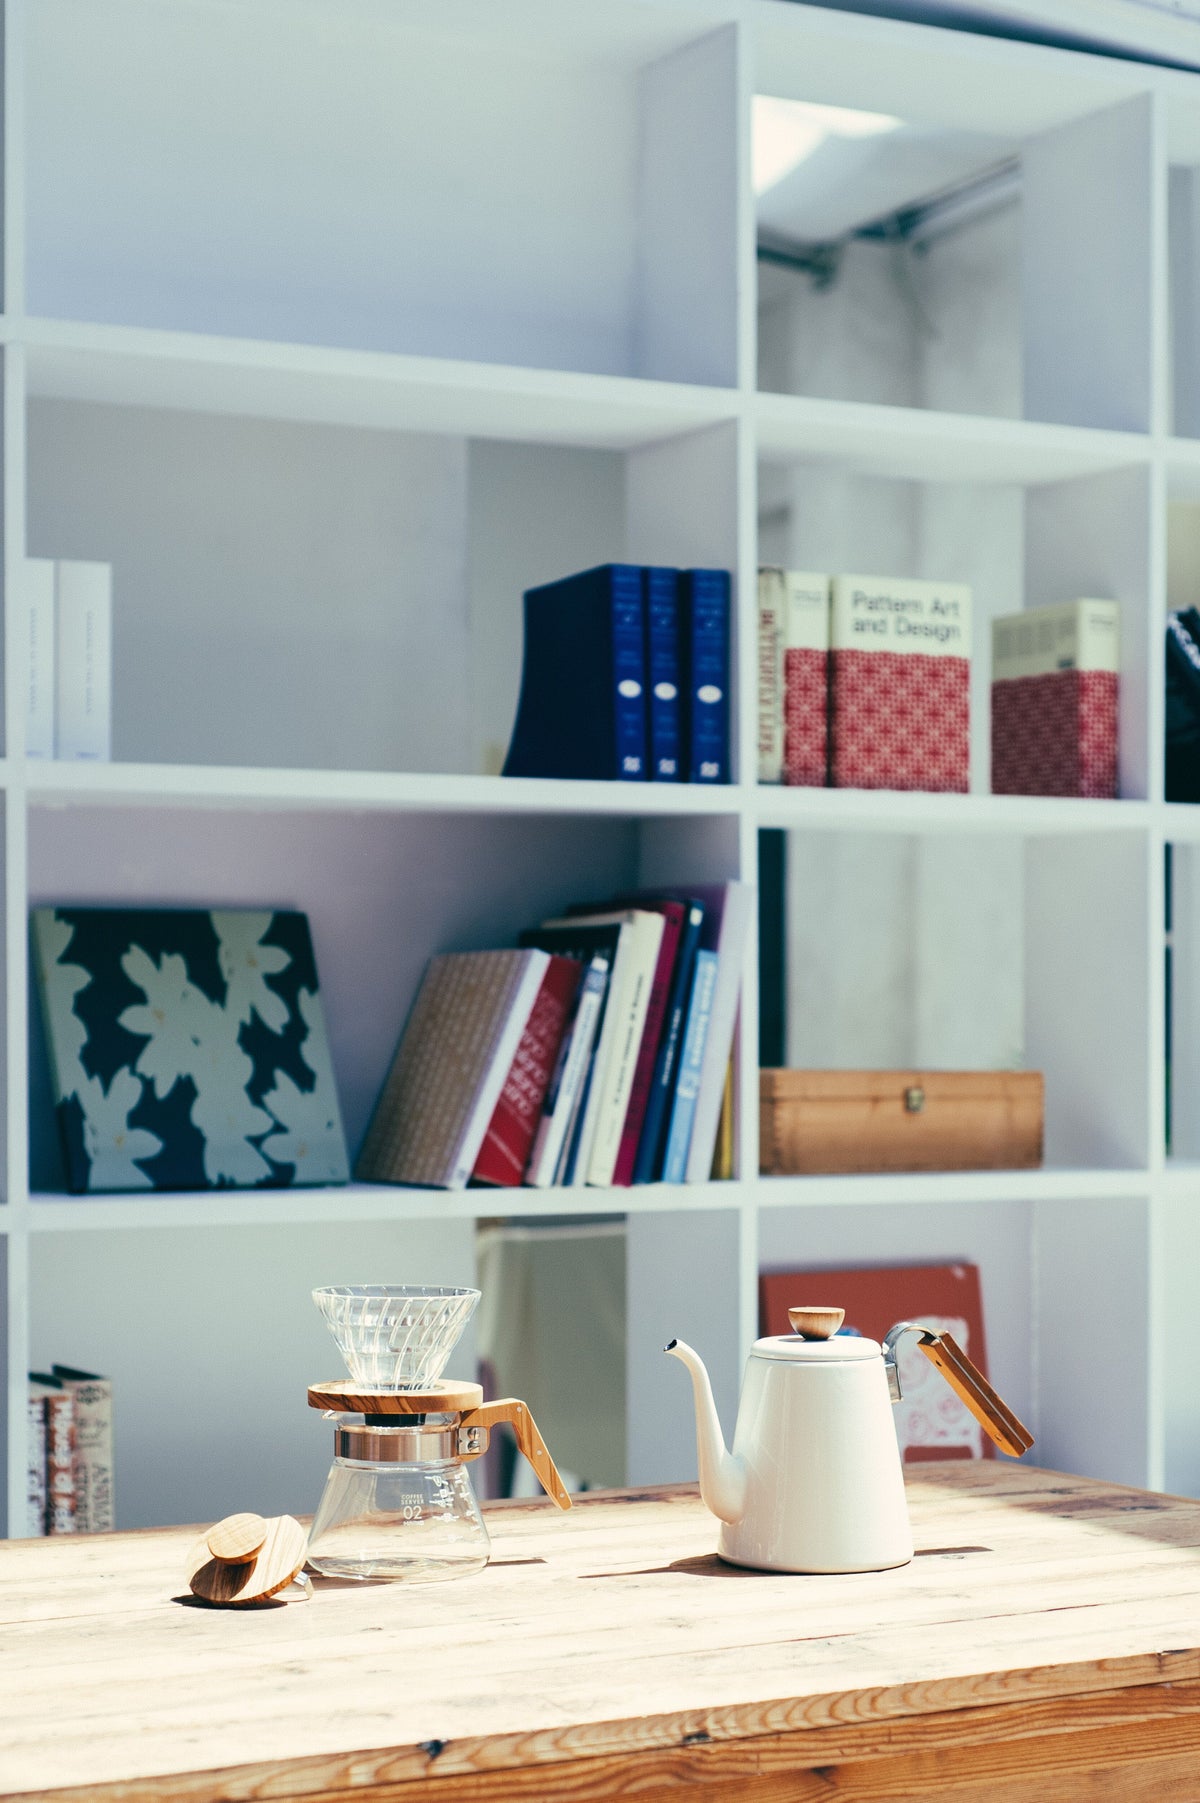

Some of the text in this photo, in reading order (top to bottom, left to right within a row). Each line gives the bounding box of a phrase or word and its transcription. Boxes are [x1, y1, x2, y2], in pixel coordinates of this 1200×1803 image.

[852, 589, 960, 616] Pattern Art
[853, 616, 961, 642] and Design
[403, 1505, 422, 1520] 02
